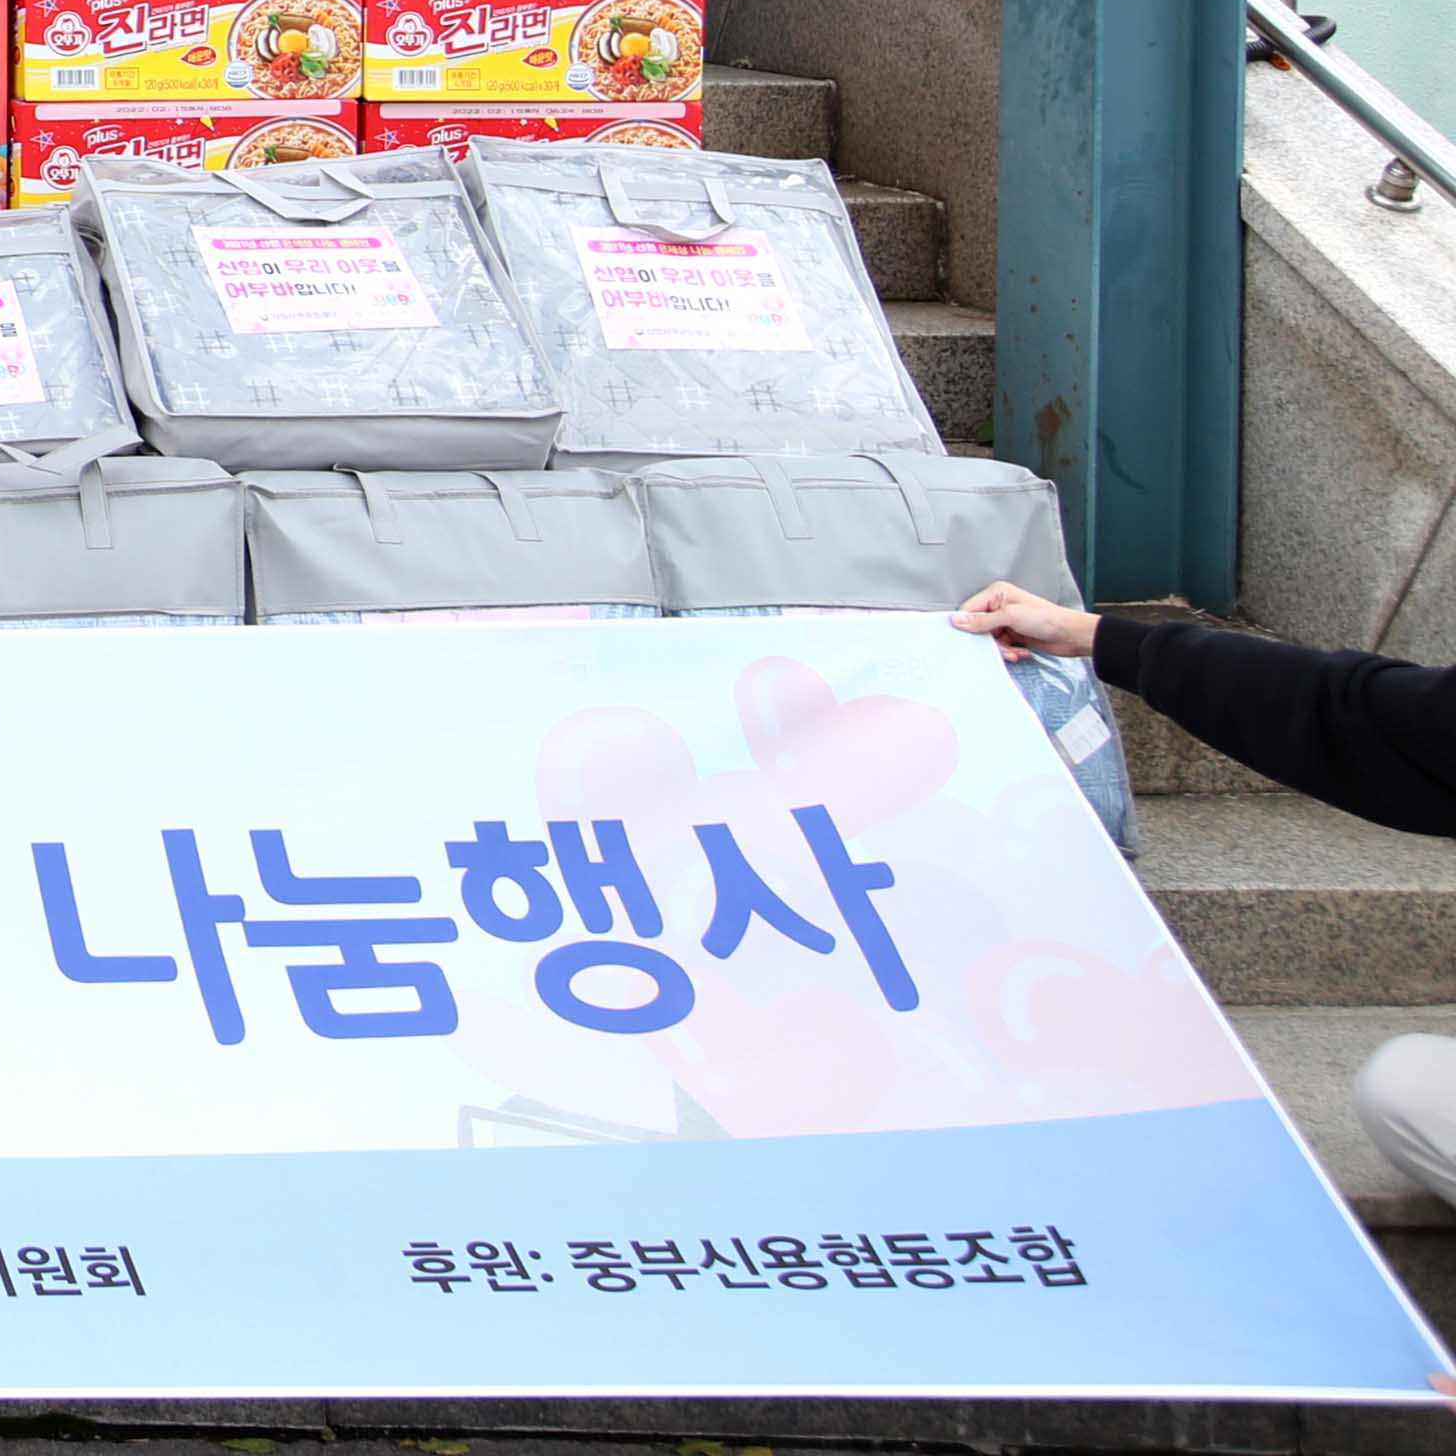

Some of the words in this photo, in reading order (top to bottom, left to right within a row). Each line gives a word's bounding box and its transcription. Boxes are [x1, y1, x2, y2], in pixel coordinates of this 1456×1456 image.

[97, 4, 209, 57] 진라면
[438, 5, 550, 58] 진라면
[32, 805, 919, 1045] 나눔행사
[403, 1241, 554, 1293] 후원:
[568, 1226, 1088, 1293] 중부신용협동조합
